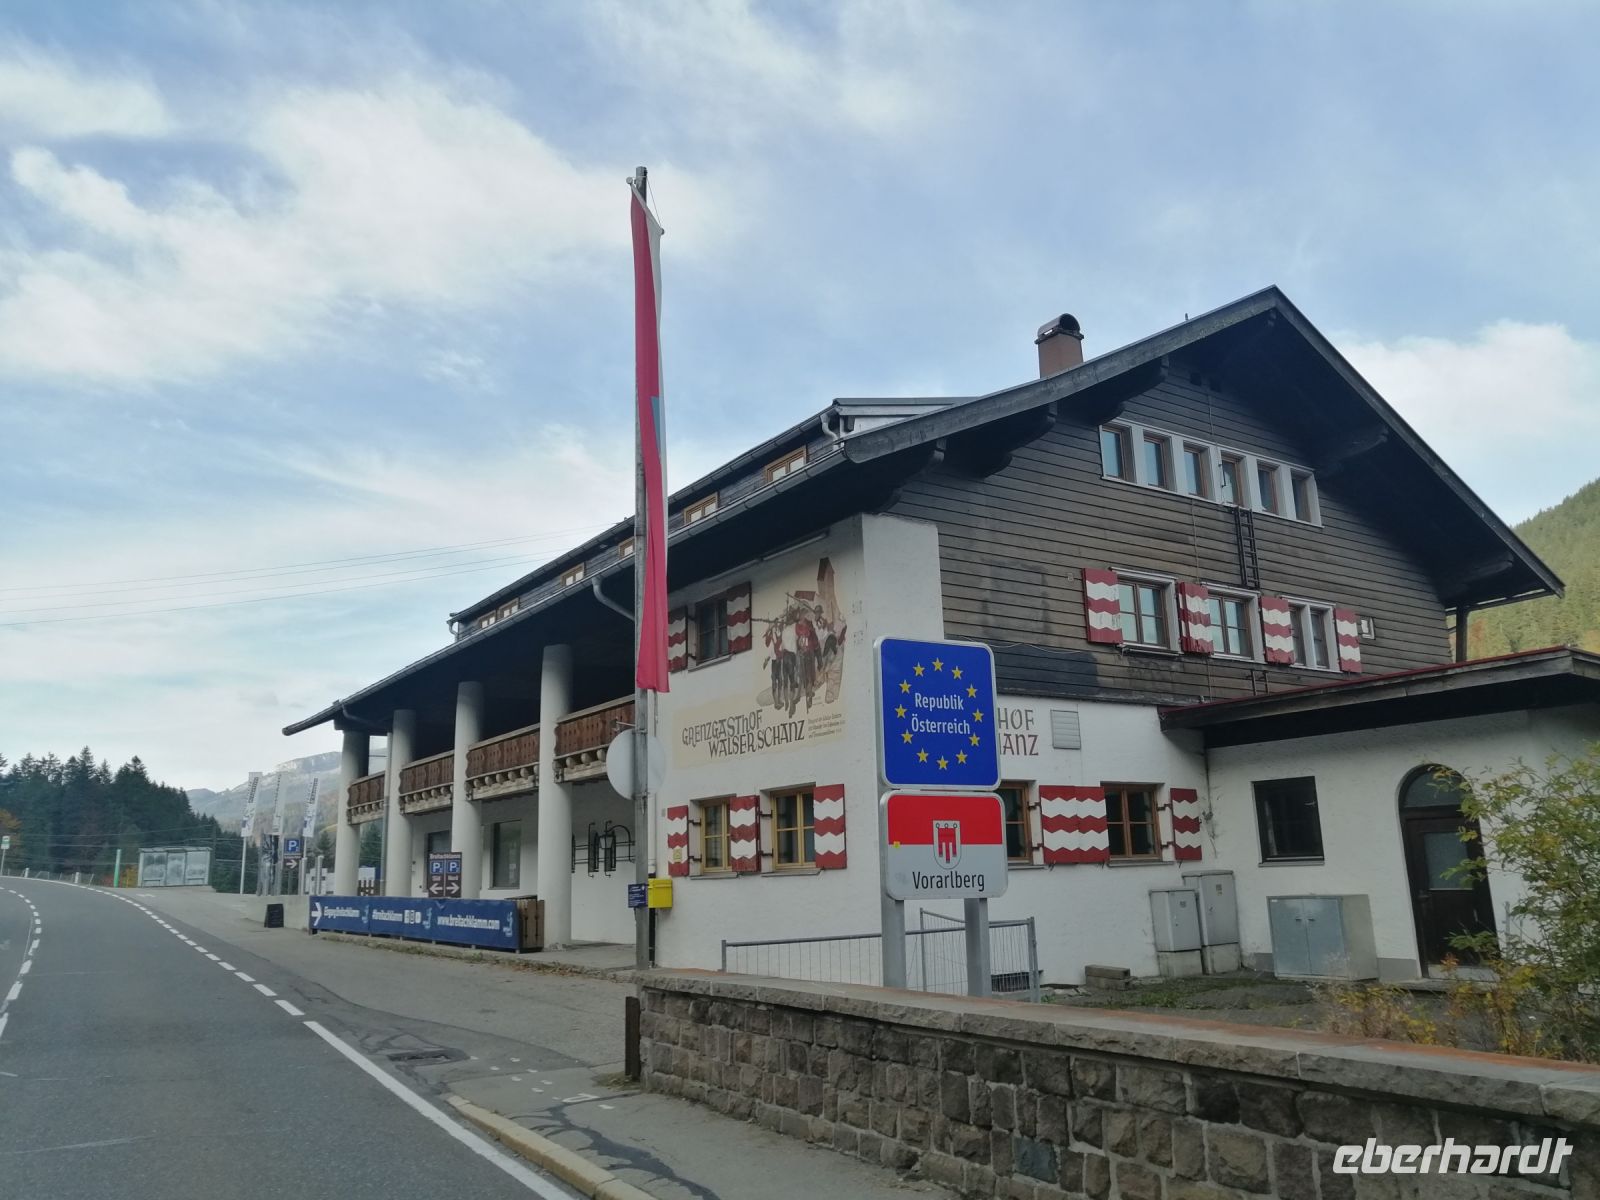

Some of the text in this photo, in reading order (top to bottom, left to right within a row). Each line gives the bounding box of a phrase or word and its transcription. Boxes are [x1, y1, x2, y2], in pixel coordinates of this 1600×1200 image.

[914, 692, 964, 711] Republik
[911, 713, 970, 734] Österreich
[708, 720, 805, 758] WALSER SCHANZ
[912, 871, 985, 892] Vorarlberg
